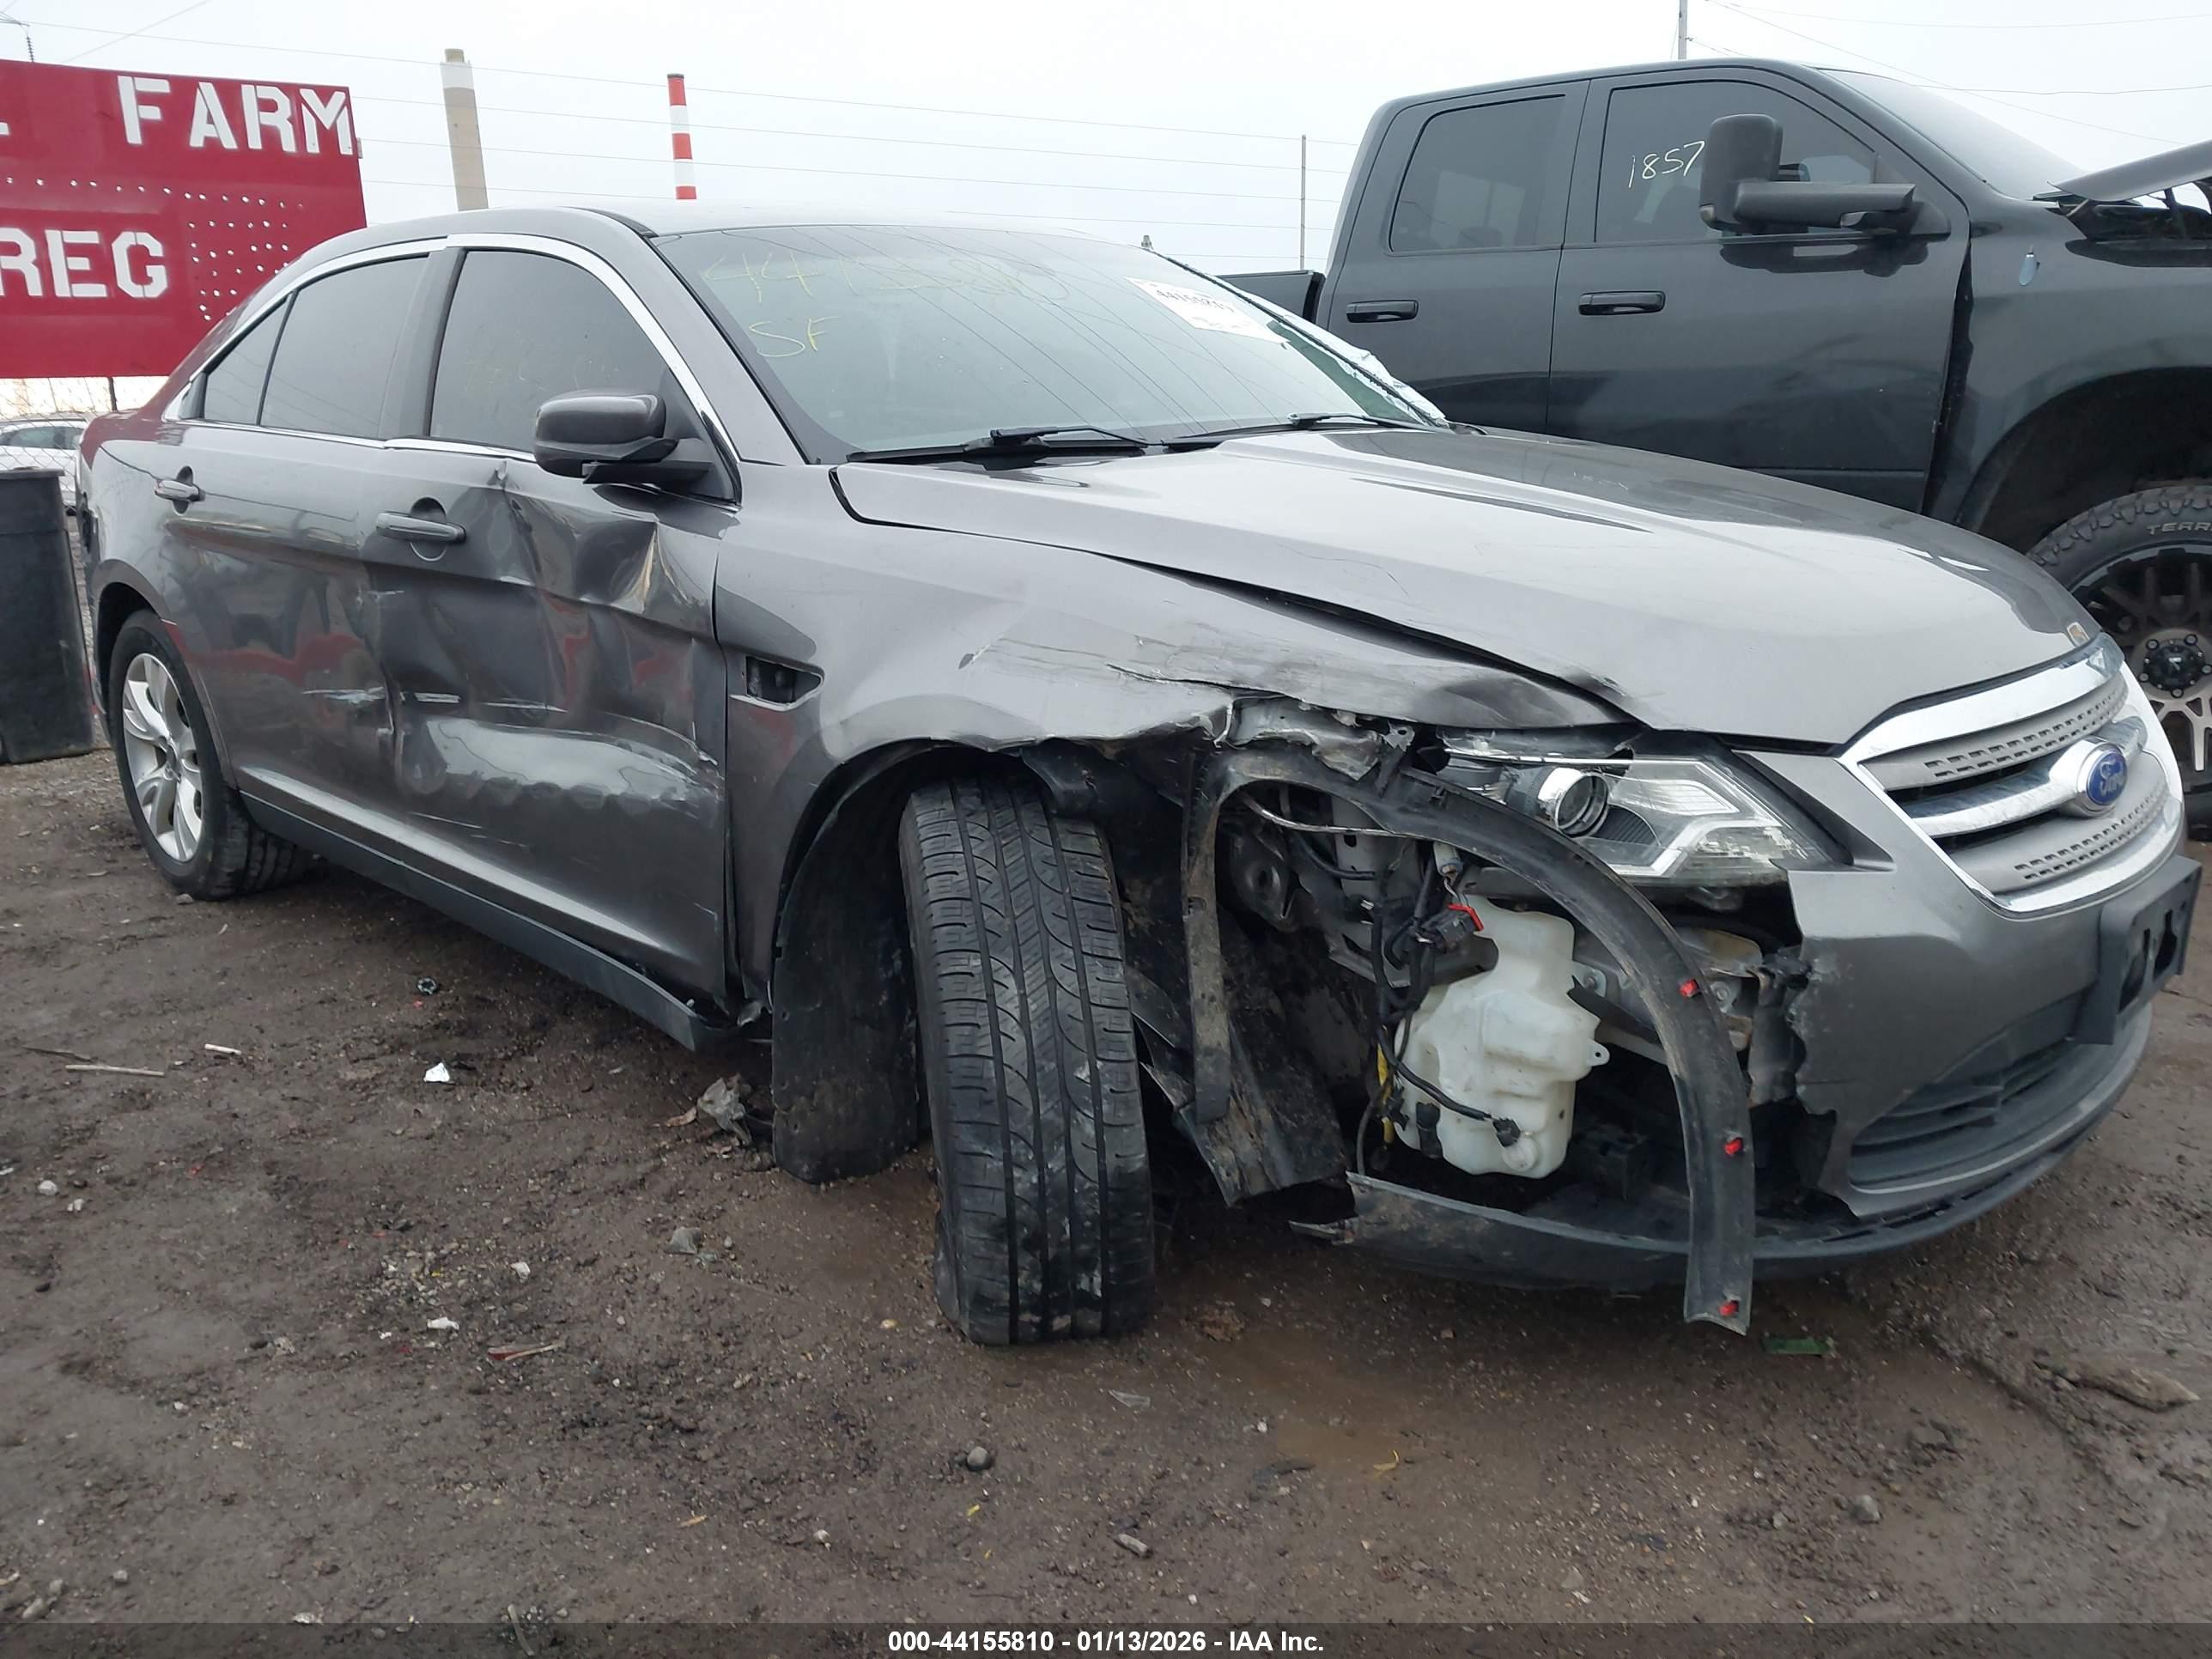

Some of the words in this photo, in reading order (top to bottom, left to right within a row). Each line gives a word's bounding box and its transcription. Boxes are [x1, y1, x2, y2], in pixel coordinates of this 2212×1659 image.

[117, 75, 353, 155] FARM
[1628, 140, 1705, 188] 1857
[0, 228, 168, 299] REG
[748, 315, 841, 357] SF
